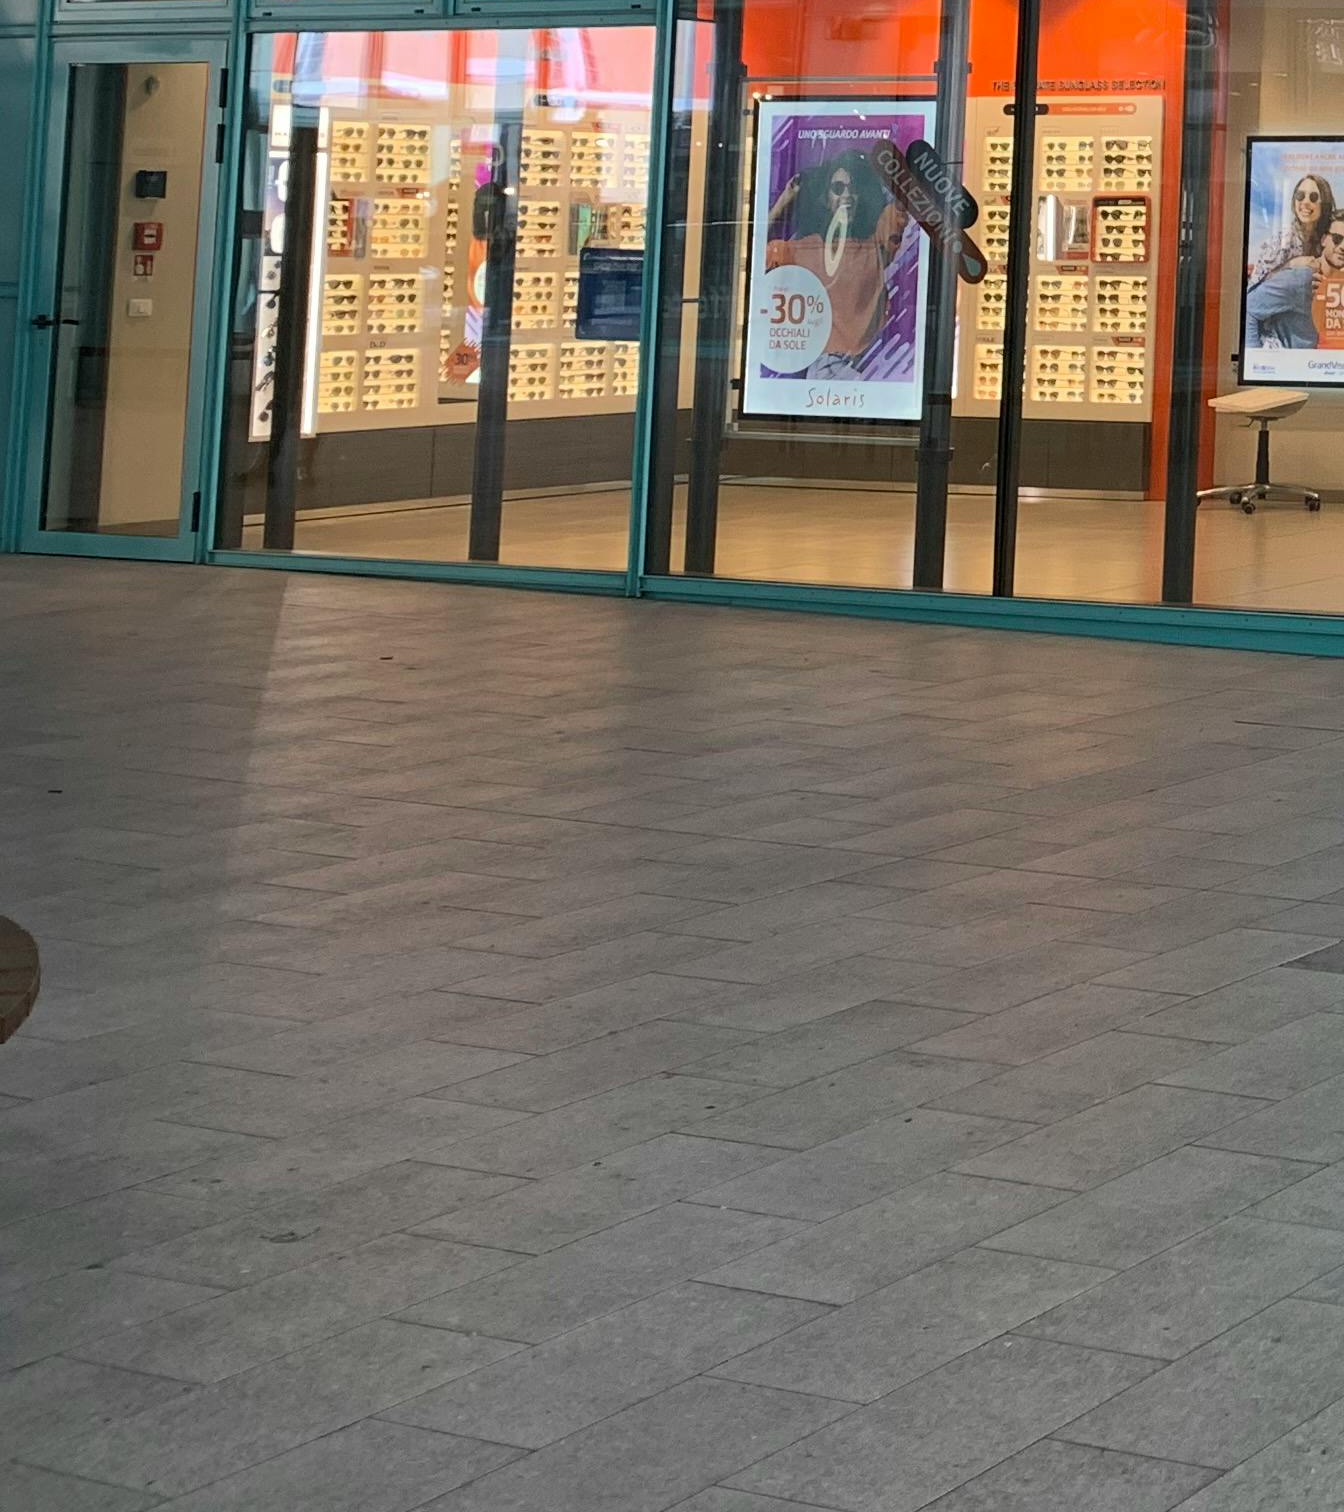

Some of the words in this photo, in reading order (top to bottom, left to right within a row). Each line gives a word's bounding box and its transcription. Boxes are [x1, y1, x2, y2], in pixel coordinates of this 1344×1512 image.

[876, 149, 959, 244] COLLEZIONI
[913, 151, 970, 216] NUOVE
[760, 293, 824, 325] -30%
[1325, 319, 1341, 329] DA
[783, 340, 806, 350] SOLE
[805, 387, 865, 408] Solaris
